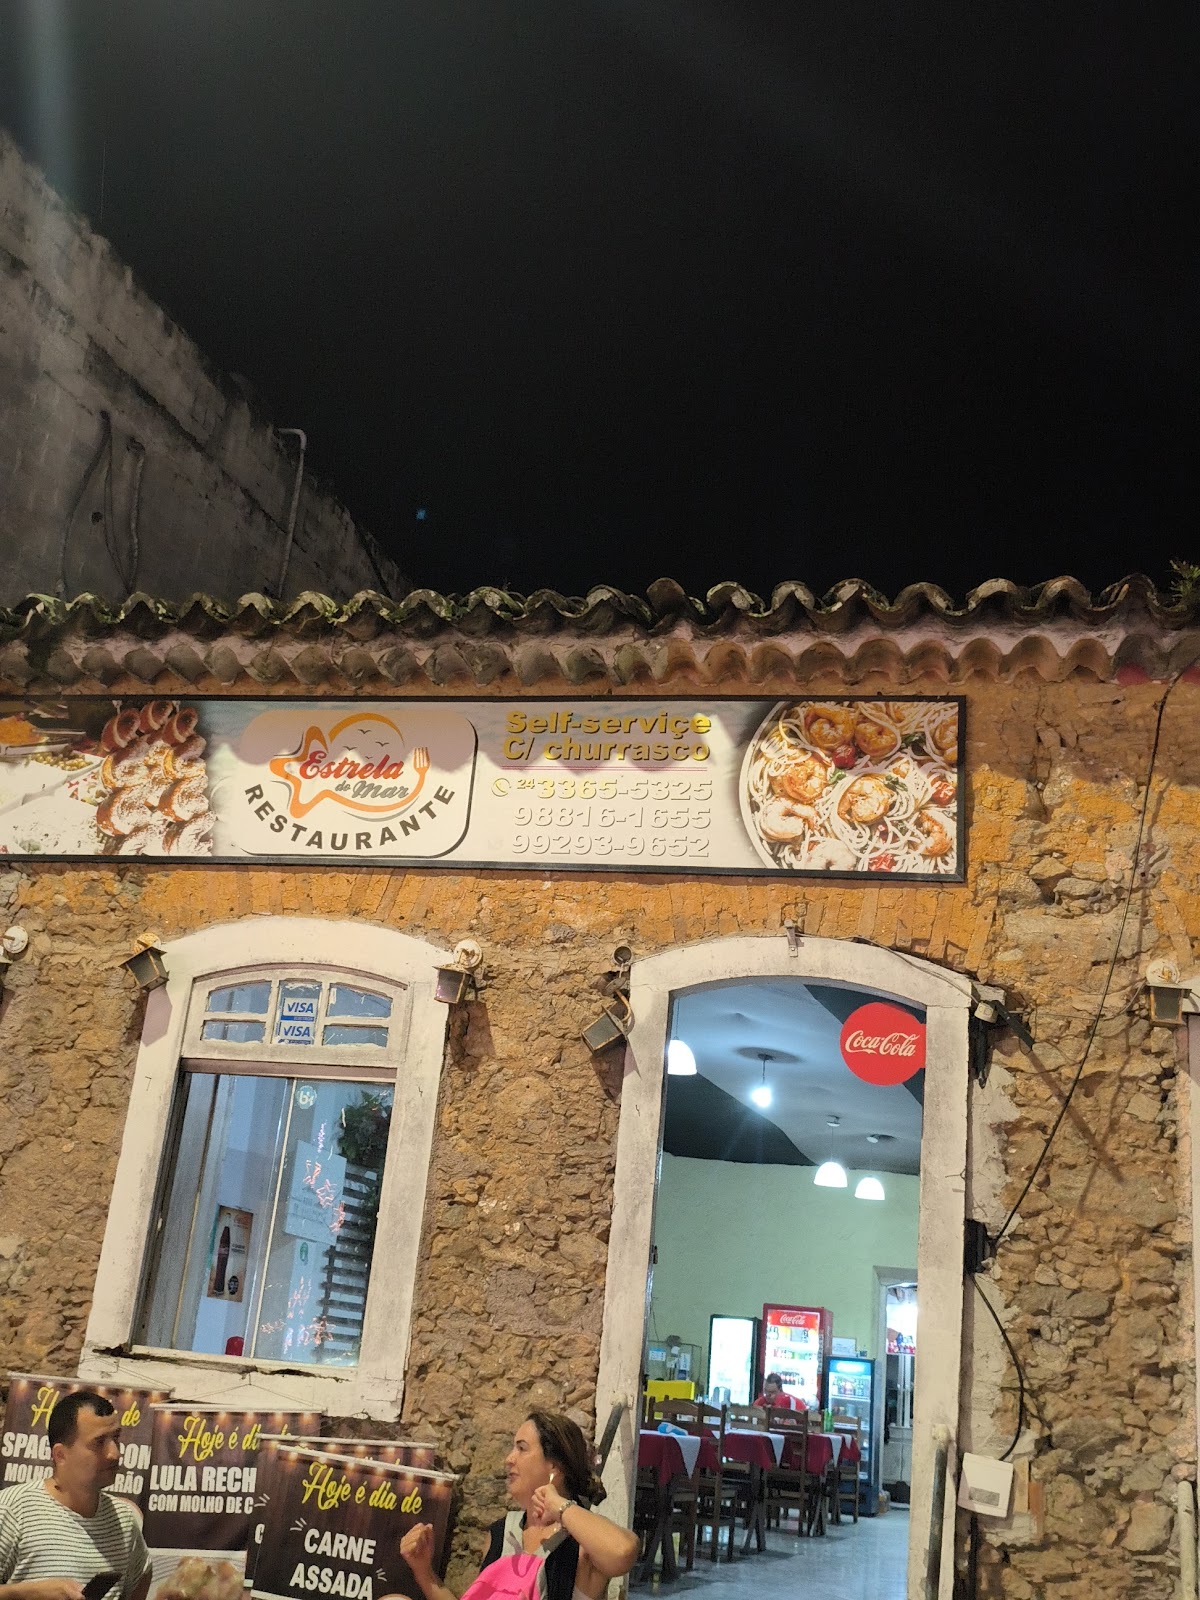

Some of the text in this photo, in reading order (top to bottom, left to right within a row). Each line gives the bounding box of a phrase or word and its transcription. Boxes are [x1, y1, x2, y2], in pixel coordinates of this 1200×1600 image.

[505, 709, 712, 739] Self-serviçe
[503, 736, 711, 762] C/ churrasco
[299, 749, 404, 781] Estrela
[351, 780, 410, 799] Mar
[244, 783, 456, 851] RESTAURANTE
[513, 806, 712, 830] 98816-1655
[512, 834, 710, 858] 99293-9652
[287, 1002, 314, 1014] VISA
[283, 1025, 310, 1037] VISA
[121, 1400, 141, 1427] de
[178, 1415, 224, 1462] Hoje
[228, 1426, 239, 1449] é
[242, 1423, 261, 1450] di
[150, 1465, 257, 1493] LULA RECH
[302, 1461, 423, 1515] Hoje é dia de
[148, 1494, 178, 1513] COM
[180, 1495, 224, 1514] MOLHO
[225, 1496, 243, 1514] DE
[304, 1528, 377, 1565] CARNE
[289, 1562, 374, 1600] ASSADA
